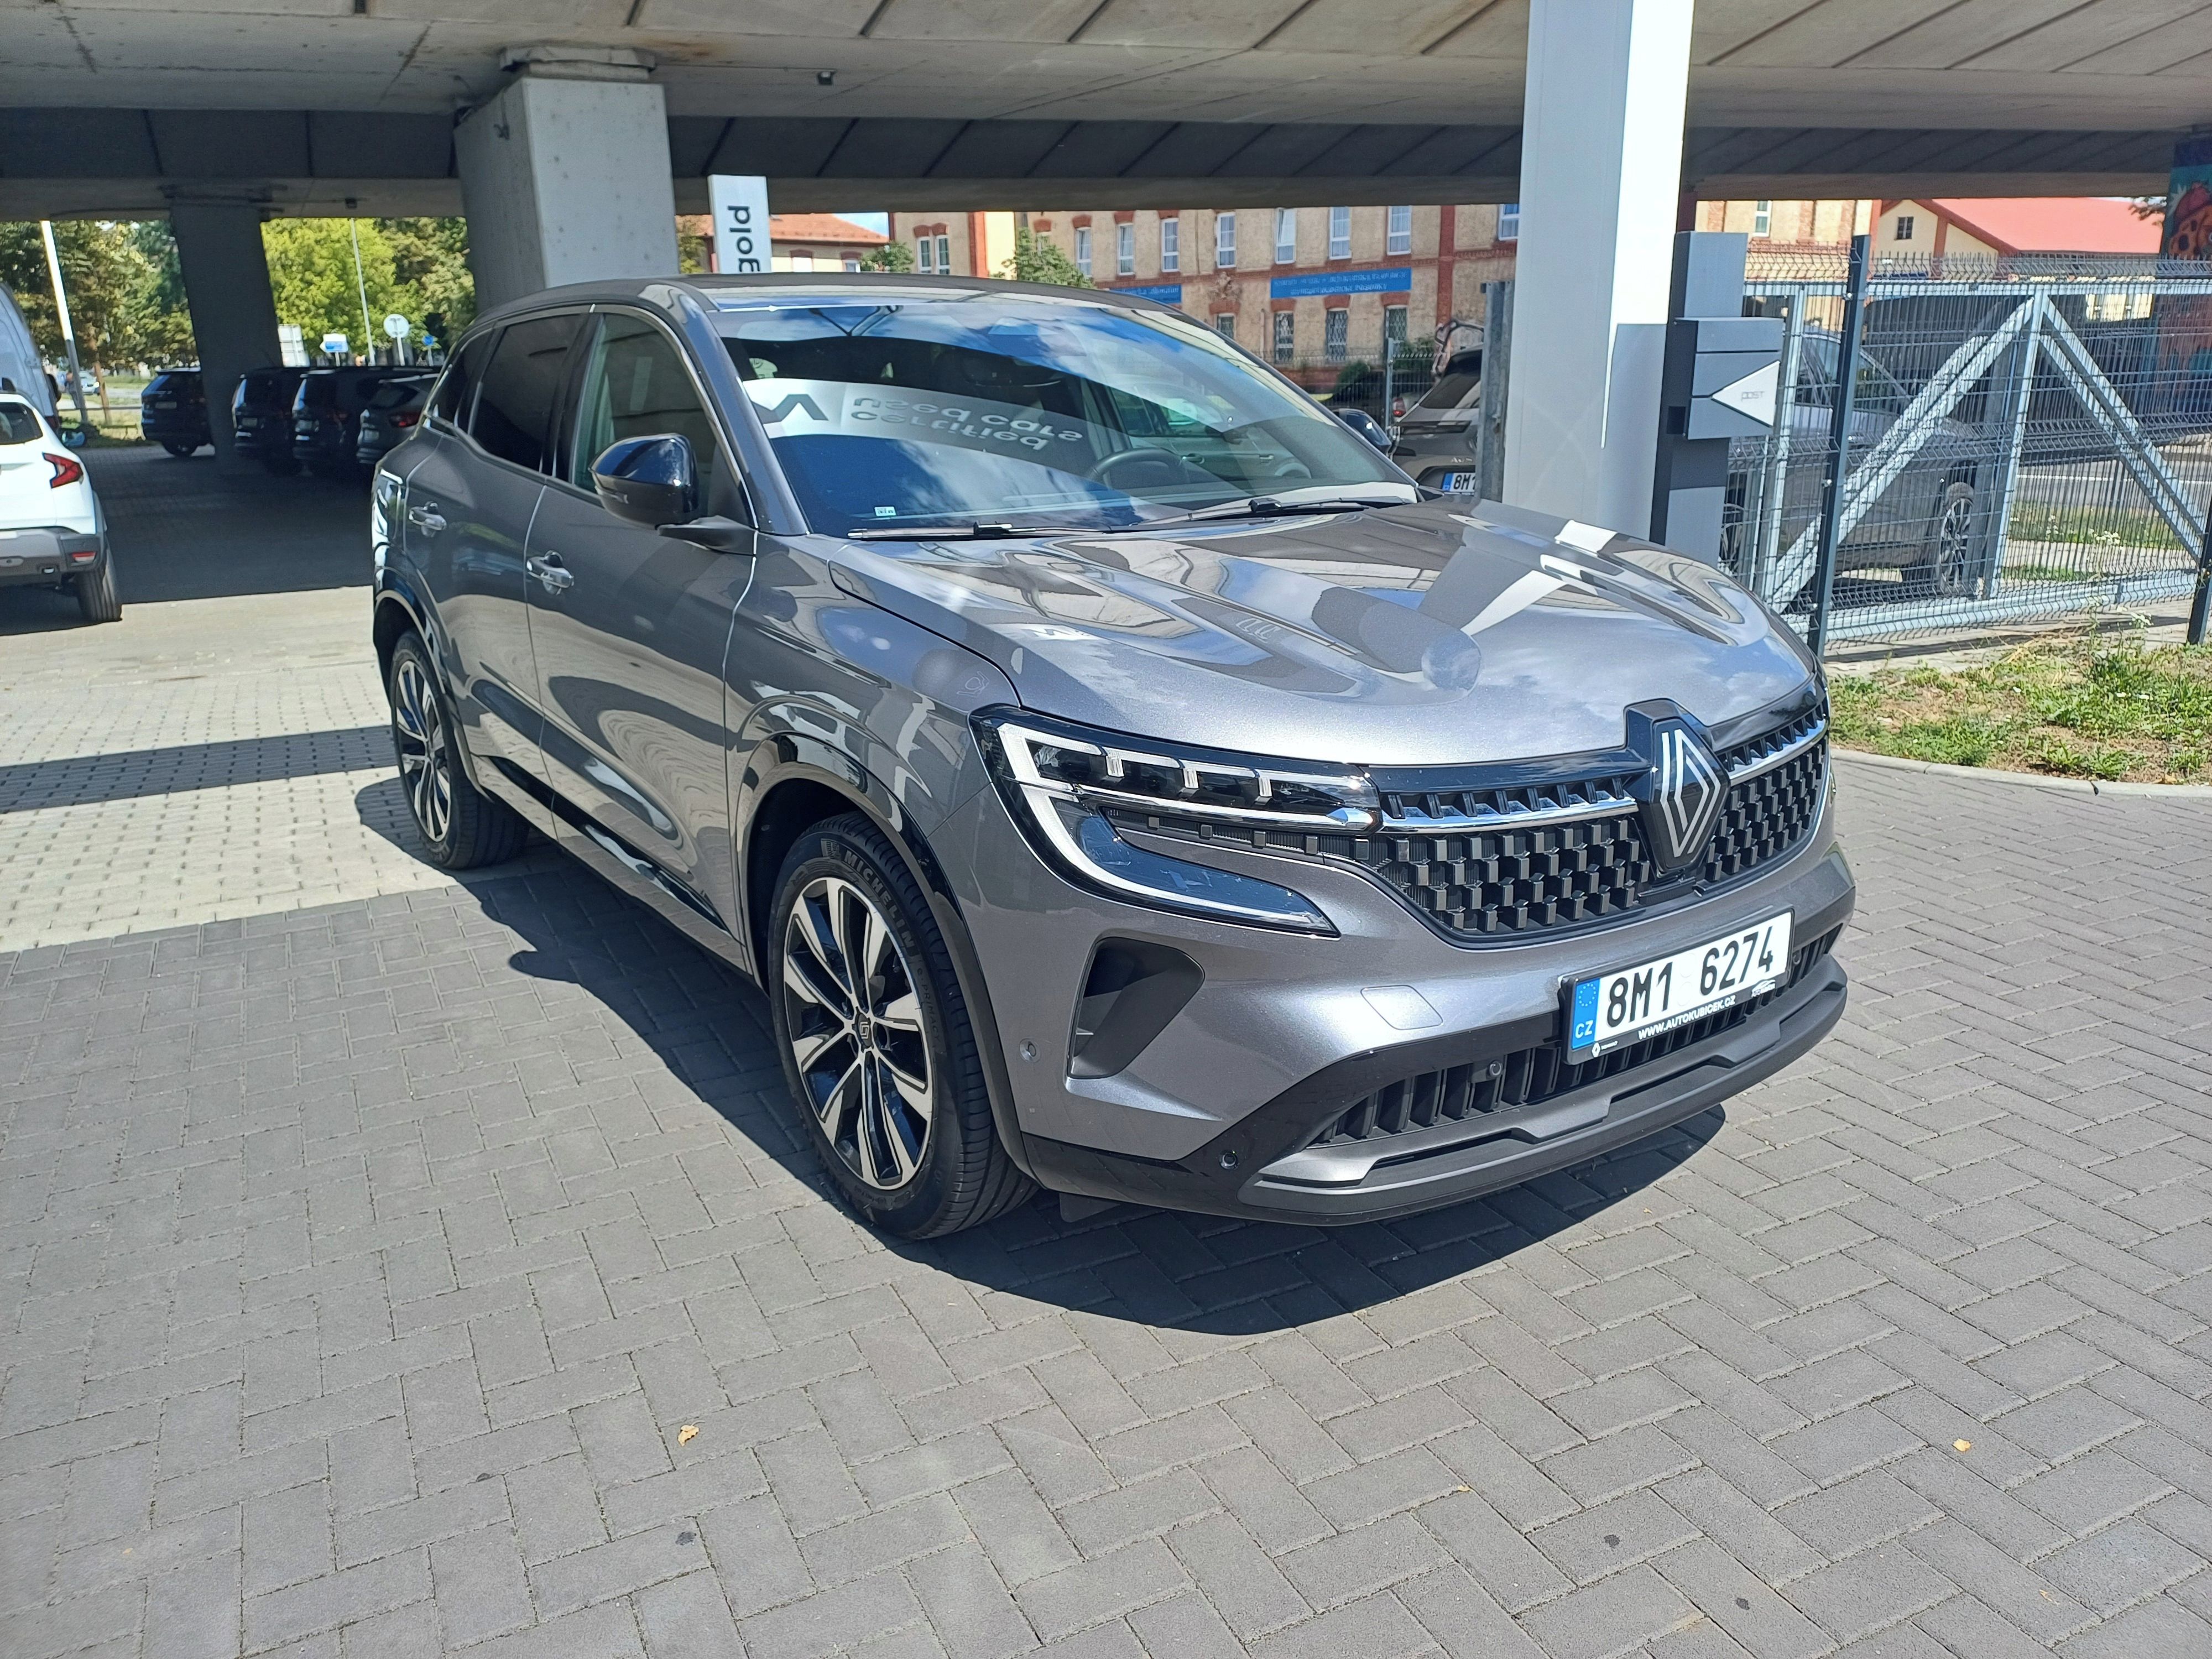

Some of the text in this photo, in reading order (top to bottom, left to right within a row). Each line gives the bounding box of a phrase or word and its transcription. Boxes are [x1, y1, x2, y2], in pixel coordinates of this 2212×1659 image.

[844, 849, 915, 948] MICHELIN
[1607, 926, 1773, 1027] 8M1 6274
[1575, 1020, 1594, 1039] CZ
